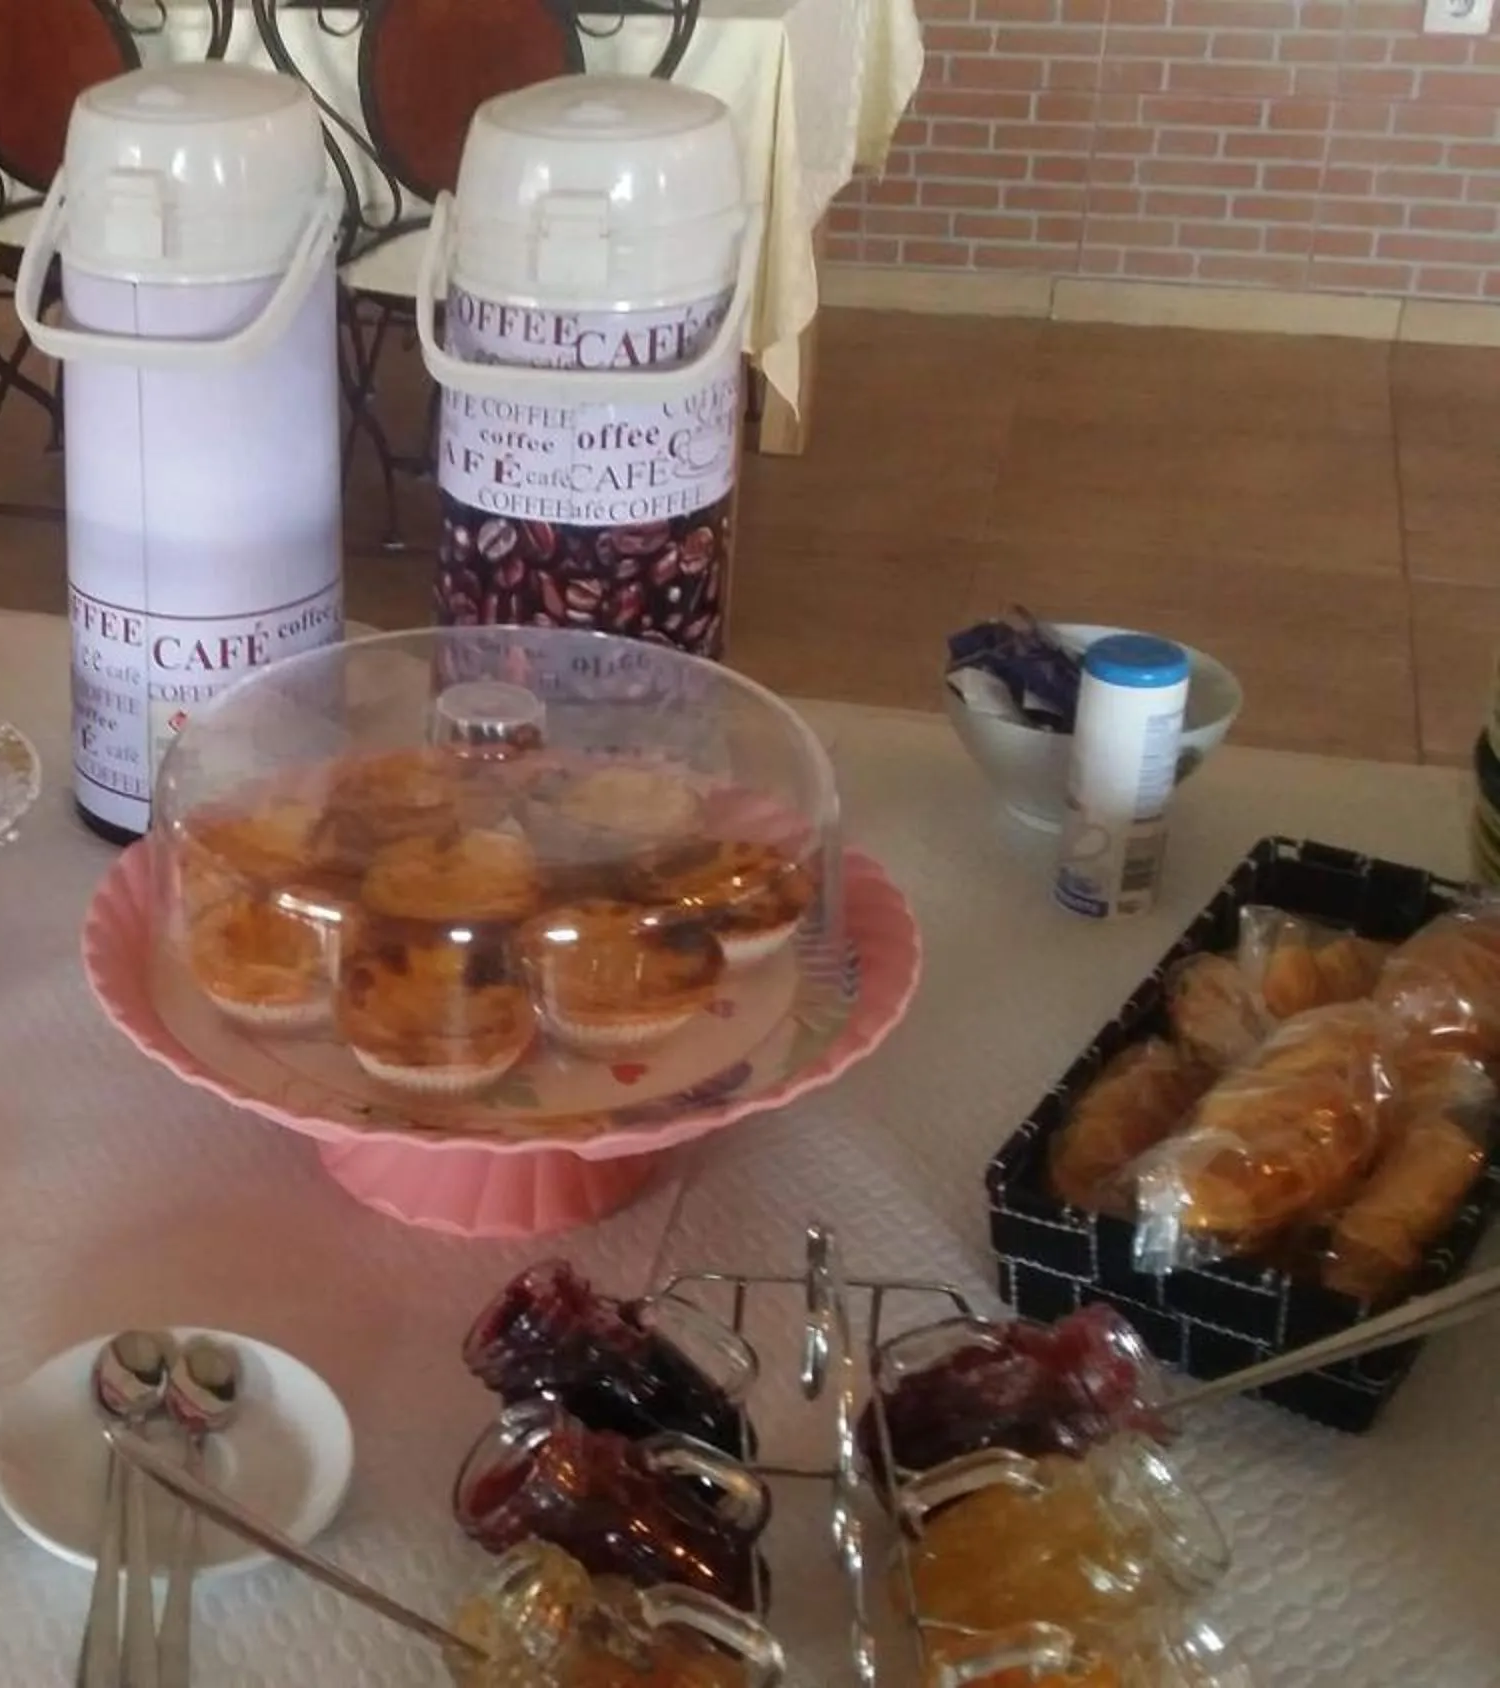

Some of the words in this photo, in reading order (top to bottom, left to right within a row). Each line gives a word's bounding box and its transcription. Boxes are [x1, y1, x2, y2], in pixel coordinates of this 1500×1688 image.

[576, 305, 700, 371] CAFÉ
[479, 429, 555, 453] coffee
[577, 421, 661, 450] offee
[153, 620, 271, 671] CAFÉ
